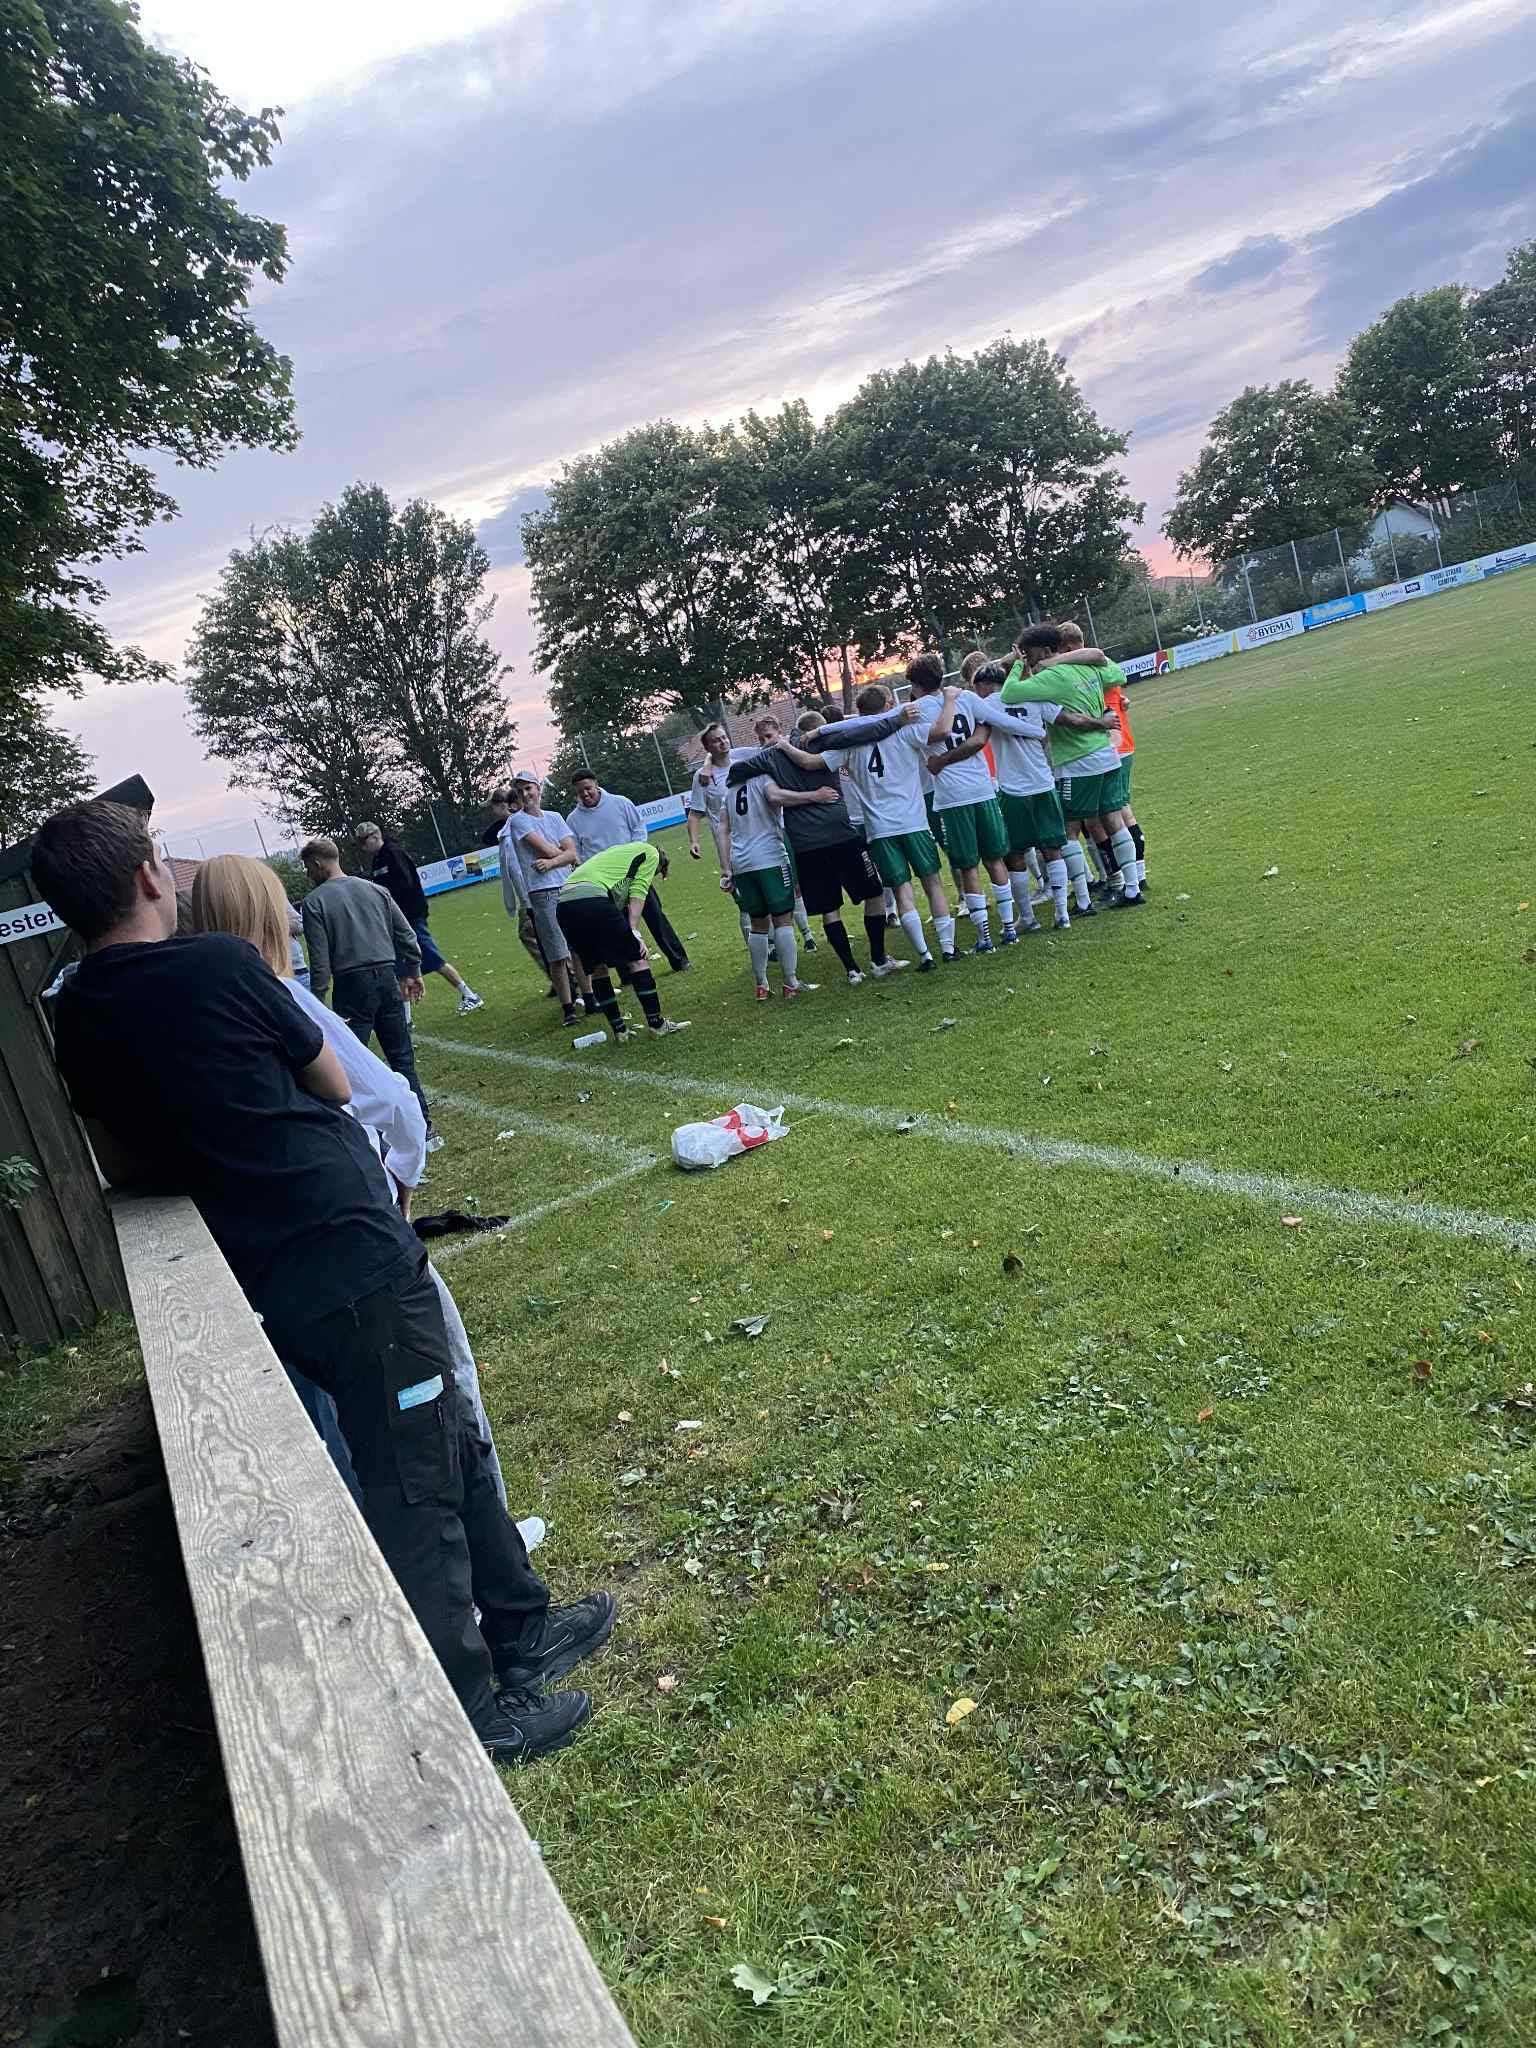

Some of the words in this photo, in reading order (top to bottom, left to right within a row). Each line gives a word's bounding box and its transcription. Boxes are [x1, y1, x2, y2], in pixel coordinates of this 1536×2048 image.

[1258, 621, 1291, 638] BYGMA
[868, 743, 884, 778] 4
[638, 804, 665, 818] ARBO
[736, 784, 748, 816] 6
